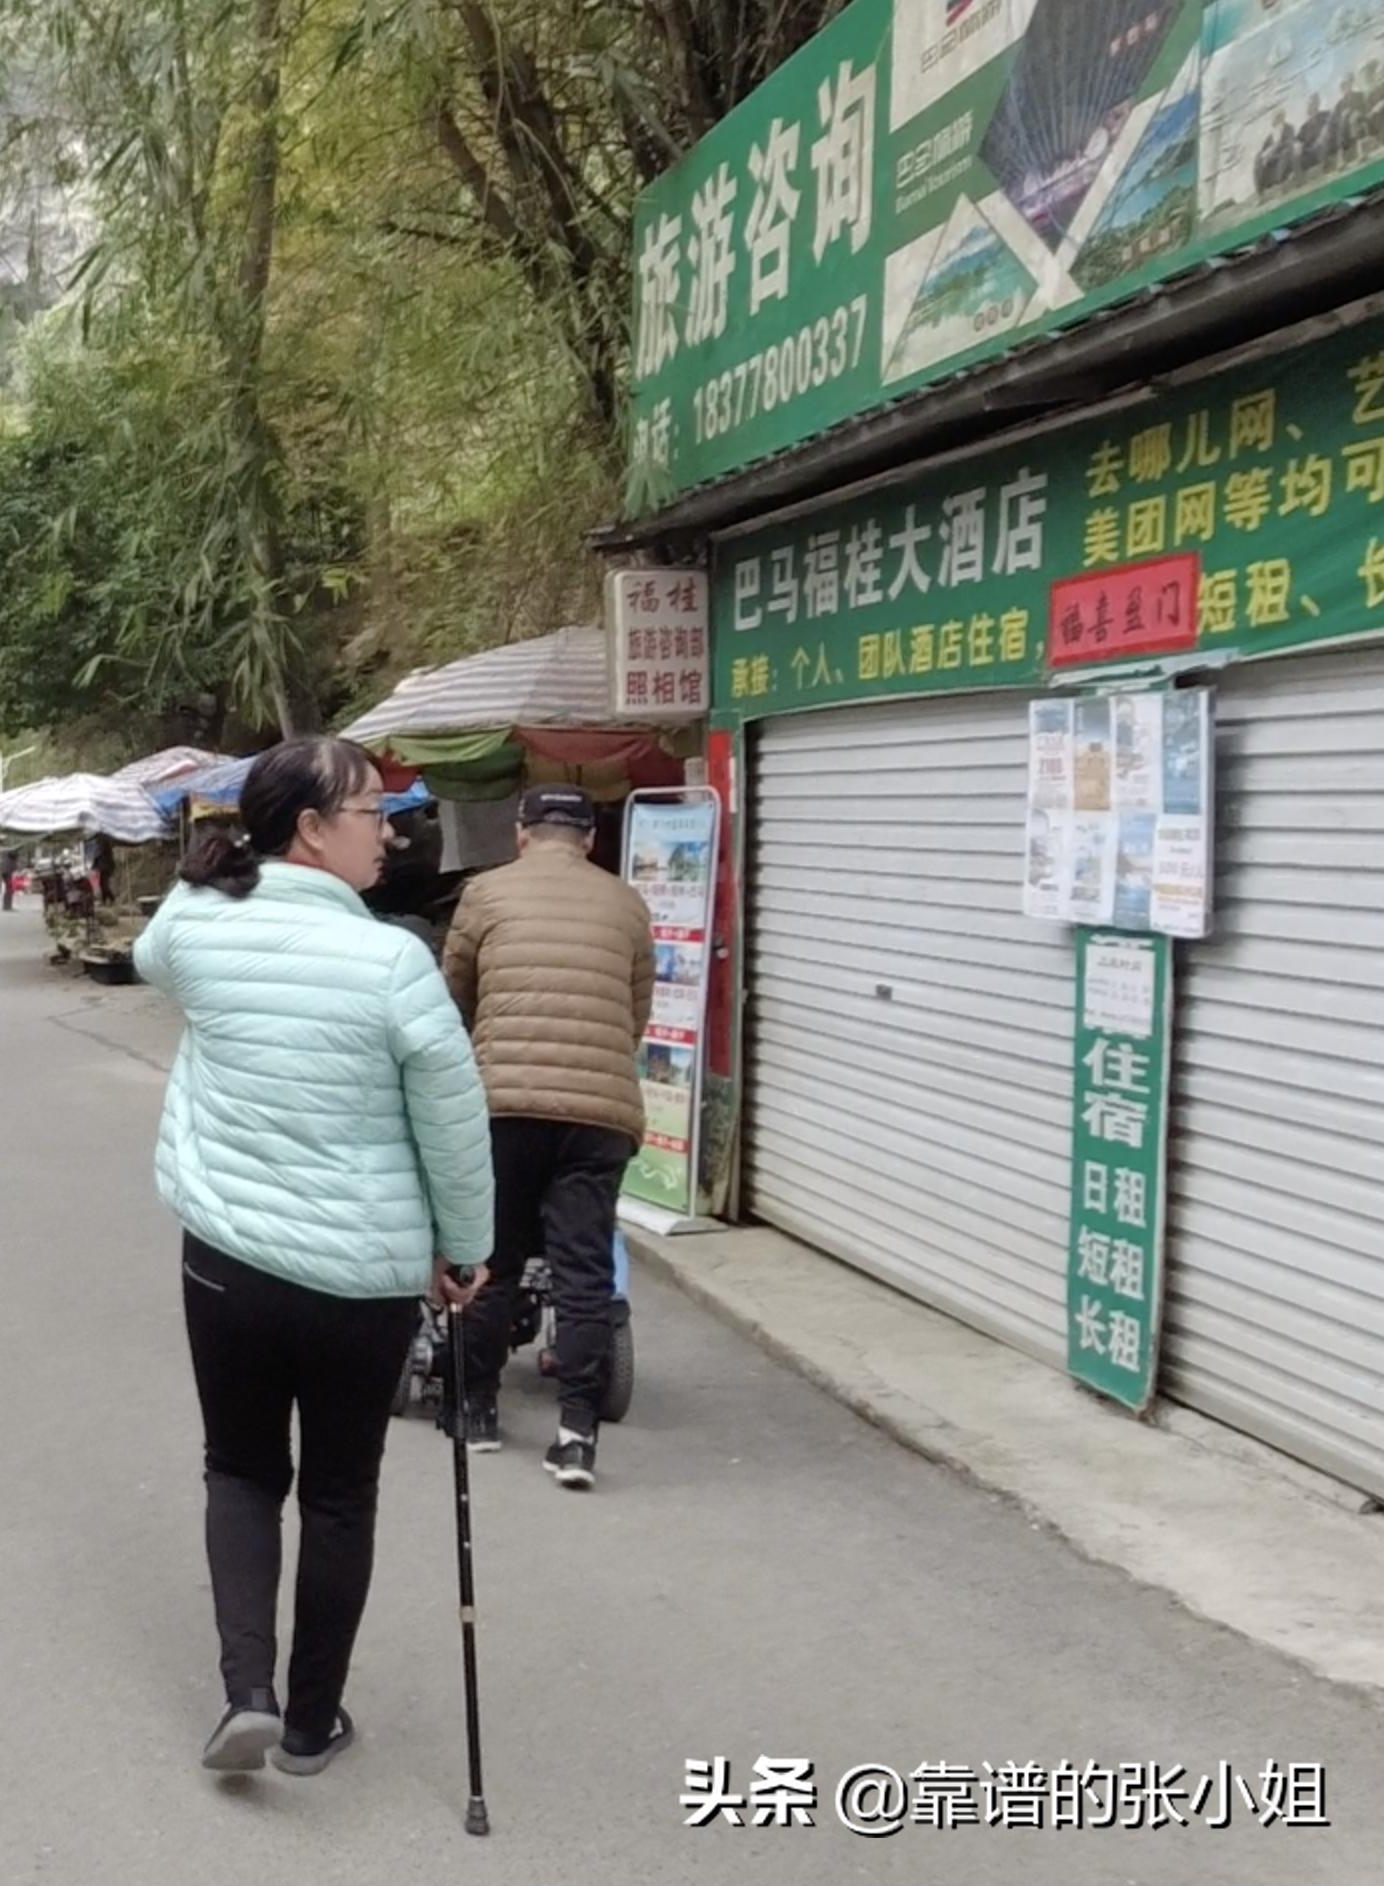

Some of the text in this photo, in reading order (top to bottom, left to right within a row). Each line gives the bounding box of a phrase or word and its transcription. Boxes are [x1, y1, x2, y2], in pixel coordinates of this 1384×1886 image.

[635, 58, 877, 381] 旅游咨询
[692, 293, 868, 444] 18377800337
[733, 466, 1049, 632] 巴马福桂大酒店
[626, 577, 699, 614] 福桂
[626, 668, 703, 706] 照相馆
[1081, 1036, 1151, 1149] 住宿
[1083, 1161, 1148, 1229] 日租
[1077, 1224, 1146, 1301] 短租
[1074, 1295, 1142, 1373] 长租
